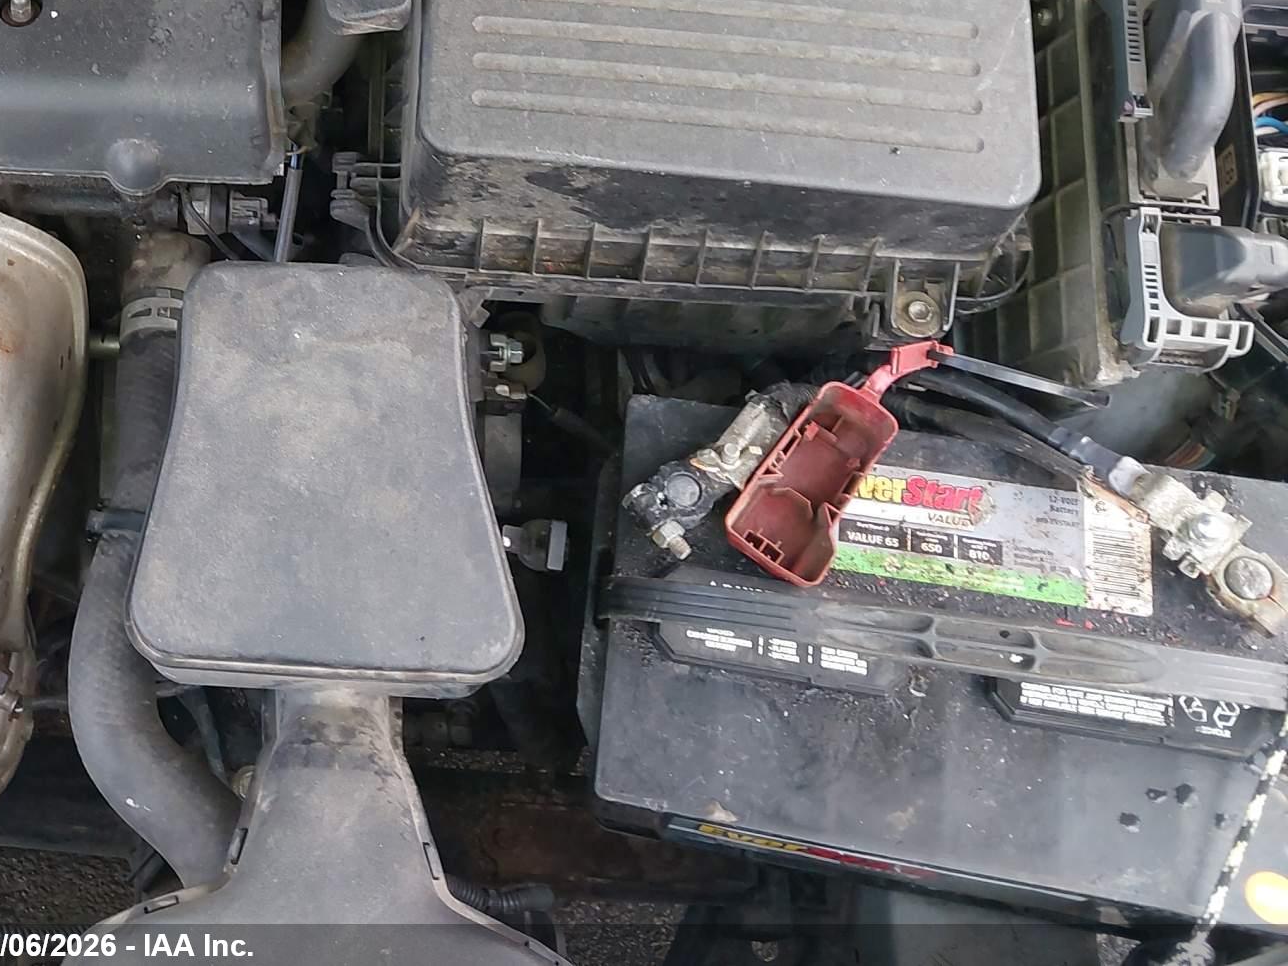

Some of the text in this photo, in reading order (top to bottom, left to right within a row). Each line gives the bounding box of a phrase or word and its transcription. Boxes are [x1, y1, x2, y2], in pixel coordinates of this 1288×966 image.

[927, 512, 970, 528] VALUE
[846, 530, 884, 546] VALUE
[885, 536, 900, 549] 65
[920, 542, 944, 554] 650
